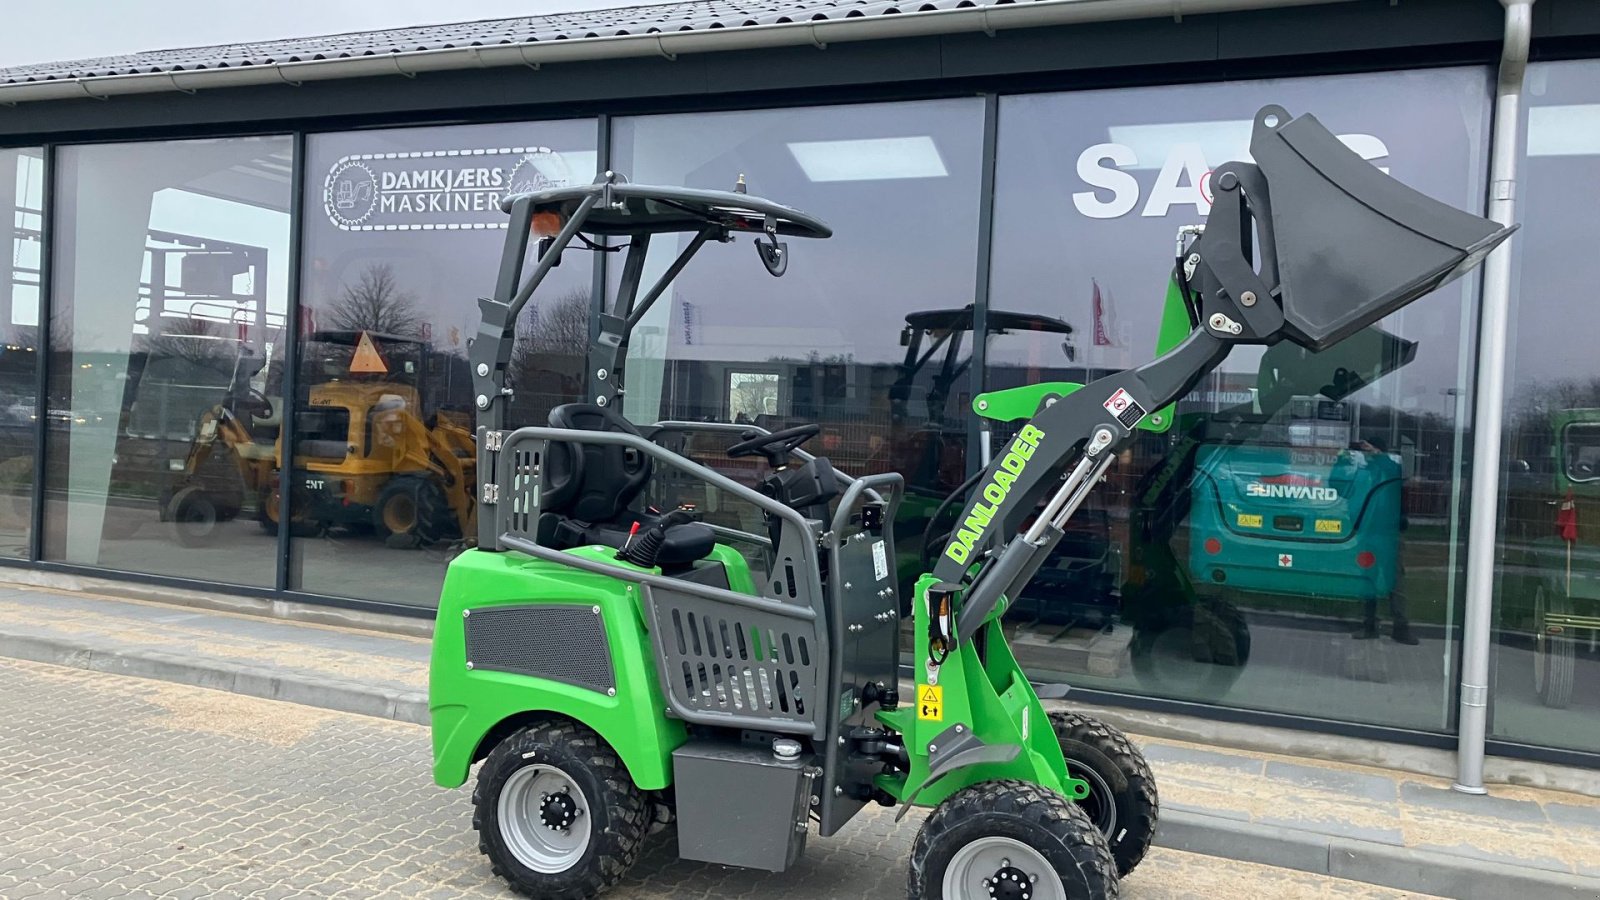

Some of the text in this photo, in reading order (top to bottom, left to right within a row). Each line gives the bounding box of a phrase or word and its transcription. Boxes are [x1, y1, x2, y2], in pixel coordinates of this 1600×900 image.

[381, 167, 503, 192] DAMKJÆRS
[380, 192, 501, 213] MASKINER
[945, 424, 1046, 566] DANLOADER
[1246, 483, 1338, 501] SUNWARD
